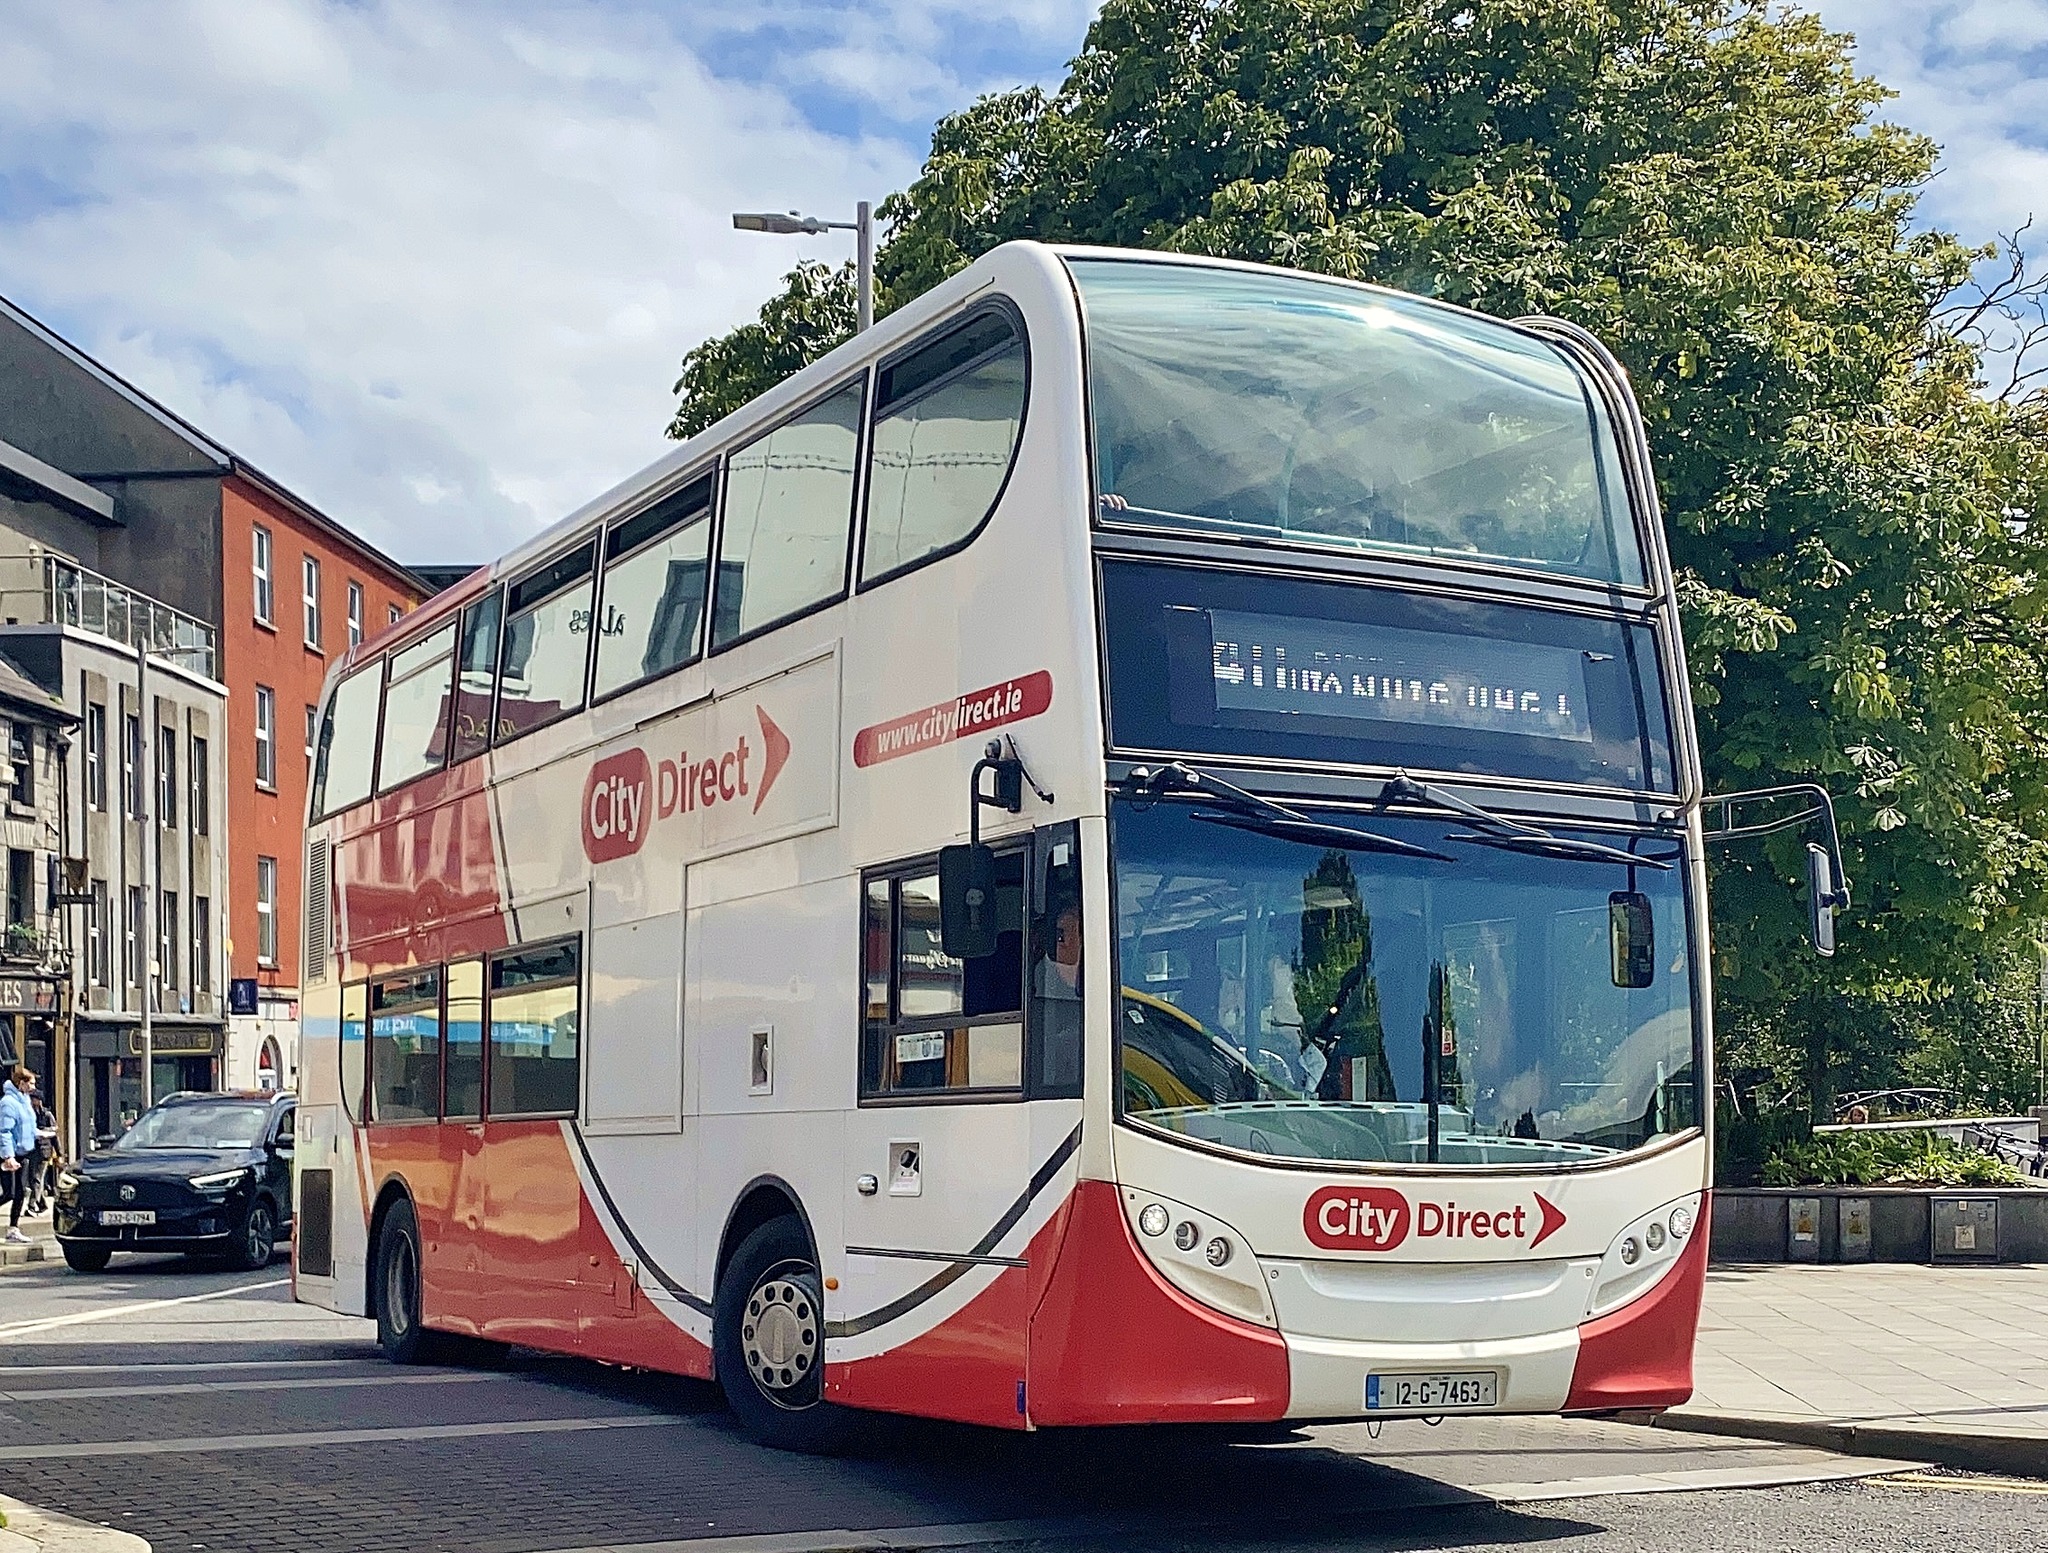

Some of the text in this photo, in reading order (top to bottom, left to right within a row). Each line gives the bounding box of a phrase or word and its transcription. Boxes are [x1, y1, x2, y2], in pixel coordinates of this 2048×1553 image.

[877, 682, 1023, 754] www.citydirect.ie
[590, 735, 750, 843] City Direct
[0, 980, 23, 1007] ES
[1318, 1198, 1526, 1245] City Direct
[1395, 1380, 1481, 1405] 12-G-7463
